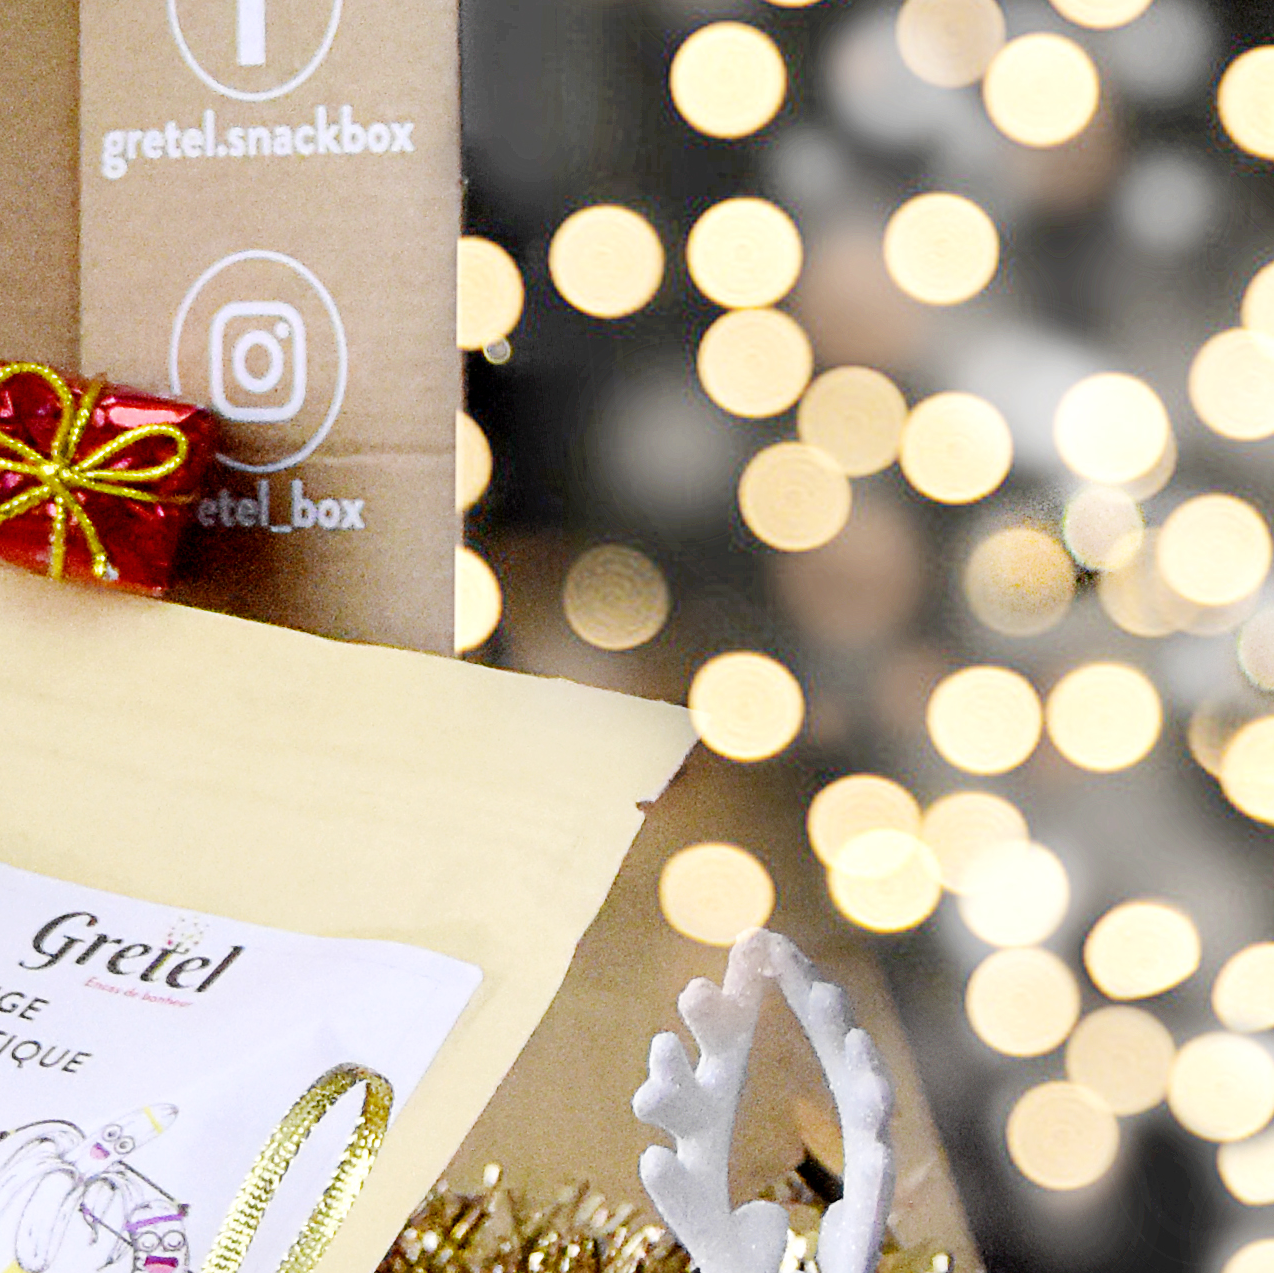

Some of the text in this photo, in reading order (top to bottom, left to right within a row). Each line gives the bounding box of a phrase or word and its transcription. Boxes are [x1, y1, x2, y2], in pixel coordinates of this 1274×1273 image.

[100, 104, 416, 180] gretel.snackbox
[197, 478, 367, 534] etel_box
[17, 910, 246, 994] Gretel
